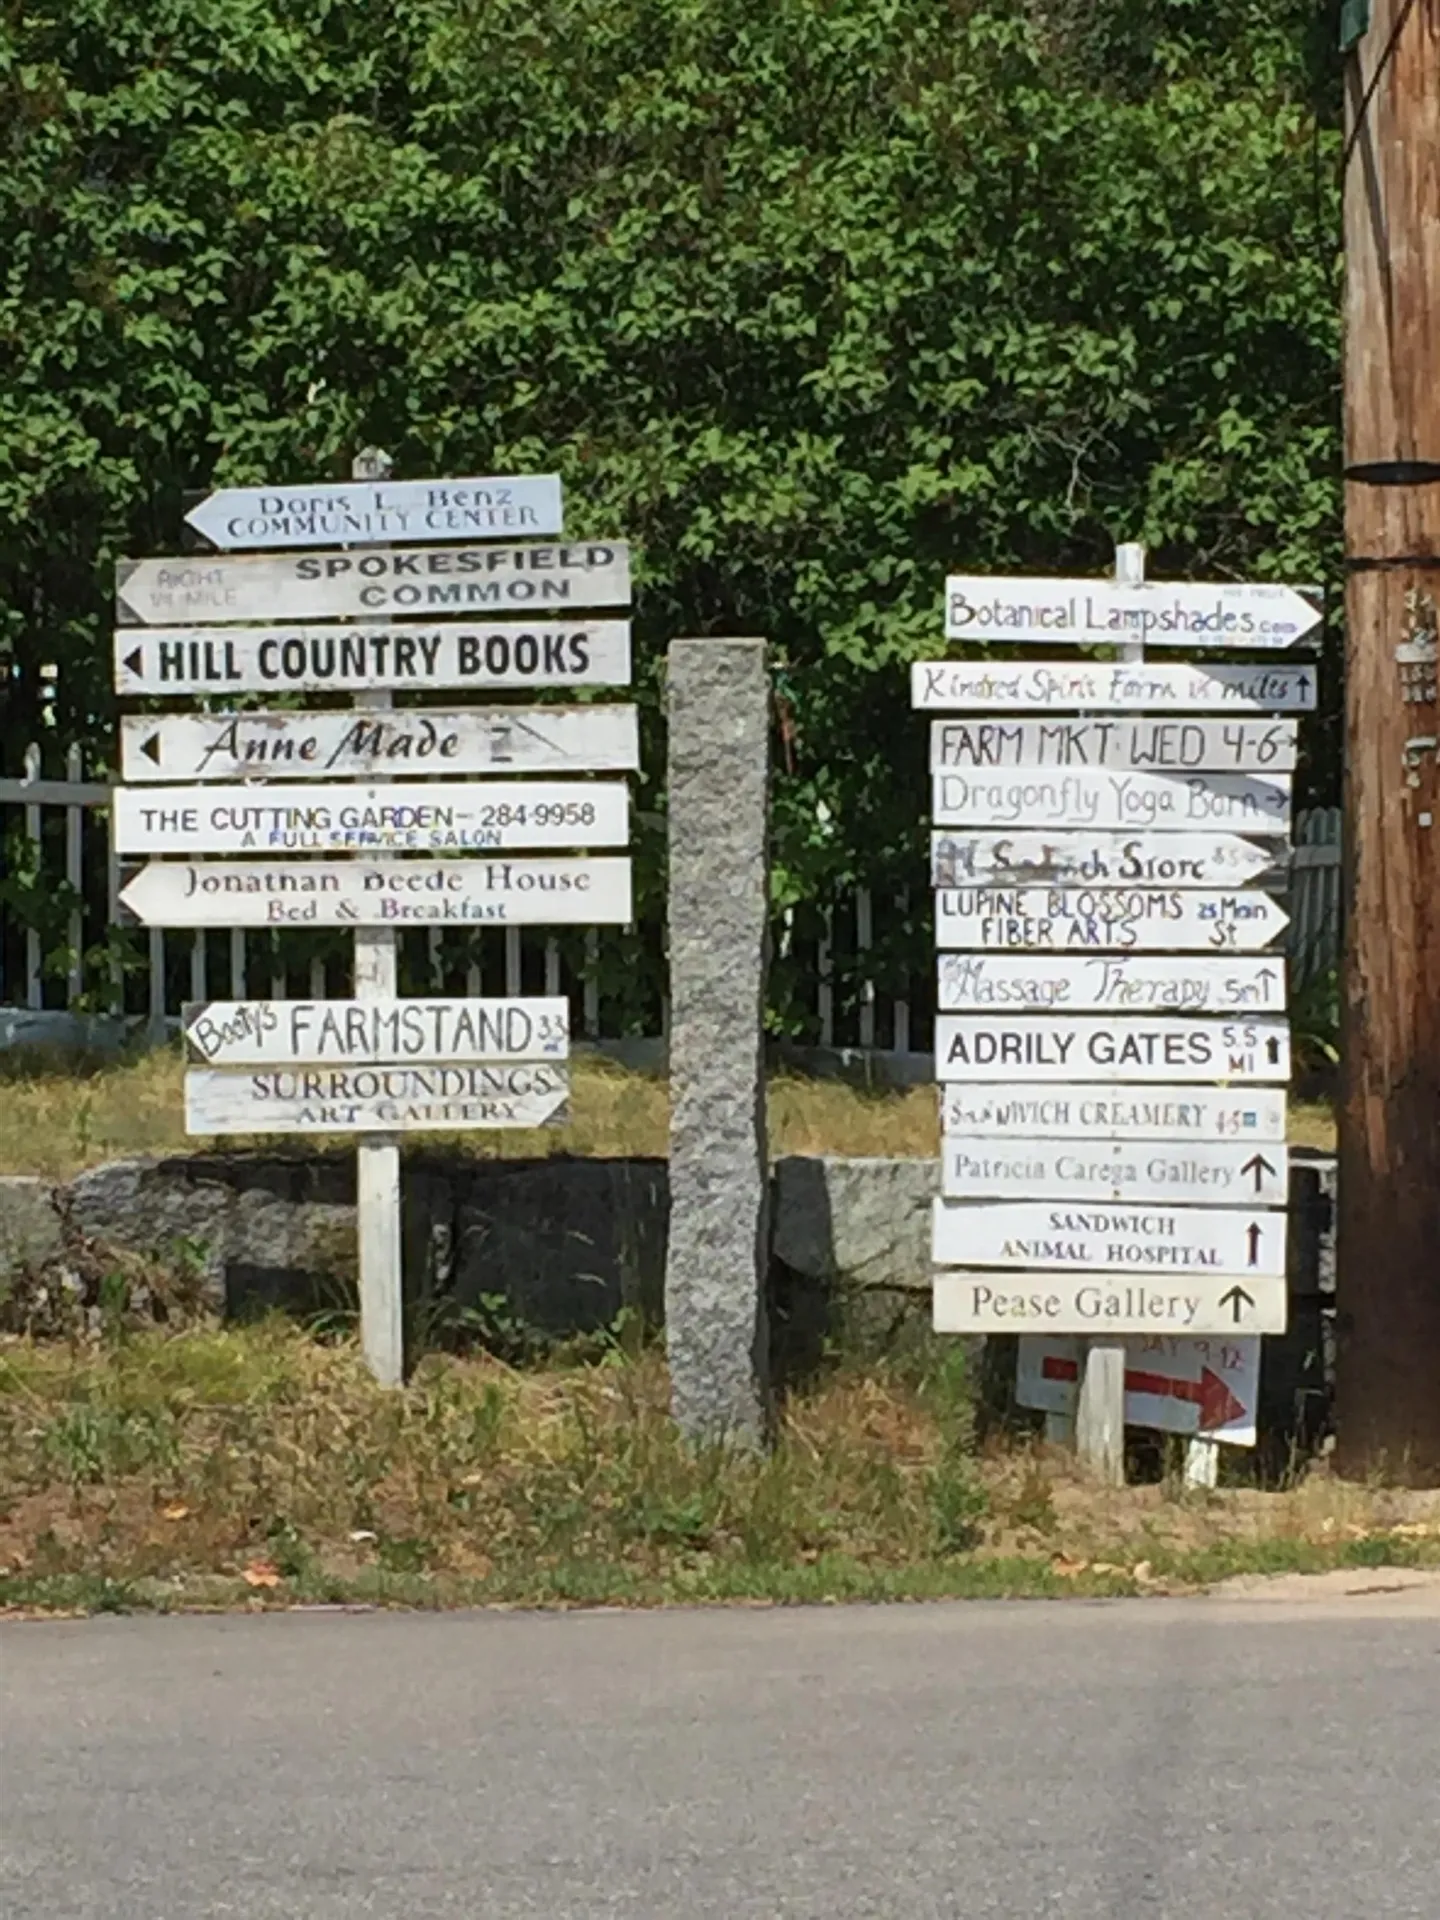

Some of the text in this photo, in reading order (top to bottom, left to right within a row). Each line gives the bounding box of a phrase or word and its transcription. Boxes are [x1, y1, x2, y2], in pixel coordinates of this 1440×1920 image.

[260, 496, 350, 516] Doris
[428, 488, 512, 508] Benz
[227, 505, 540, 538] COMMUNITY CENTER
[296, 546, 614, 580] SPOKESFIELD
[359, 579, 571, 607] COMMON
[949, 594, 1077, 629] Botanical
[158, 632, 590, 681] HILL COUNTRY BOOKS
[1107, 668, 1178, 703] Farm
[1219, 673, 1290, 700] miles
[195, 719, 460, 773] Anne Made
[940, 722, 1279, 767] FARM MKT WED 4-6
[940, 774, 1260, 824] Dragonfly Yoga Barn
[140, 808, 198, 832] THE
[210, 807, 332, 830] CUTTING
[240, 830, 502, 848] A FULL SERVICE SALON
[185, 868, 340, 897] Jonathan
[484, 863, 591, 892] House
[267, 896, 507, 922] Bed & Breakfast
[942, 891, 1028, 917] LUPINE
[1047, 890, 1183, 919] BLOSSOMS
[981, 918, 1138, 947] FIBER ARTS
[1208, 920, 1238, 946] St
[943, 958, 1071, 1006] Massage
[1084, 957, 1210, 1009] Therapy
[290, 1005, 532, 1055] FARMSTAND
[946, 1032, 1075, 1065] ADRILY
[1087, 1031, 1213, 1066] GATES
[1228, 1053, 1255, 1074] MI
[251, 1069, 557, 1102] SURROUNDINGS
[298, 1102, 517, 1124] ART GALLERY
[1079, 1101, 1208, 1129] CREAMERY
[954, 1153, 1236, 1189] Patricia Carega Gallery
[1049, 1211, 1175, 1235] SANDWICH
[1000, 1241, 1224, 1267] ANIMAL HOSPITAL
[972, 1286, 1201, 1324] Pease Gallery
